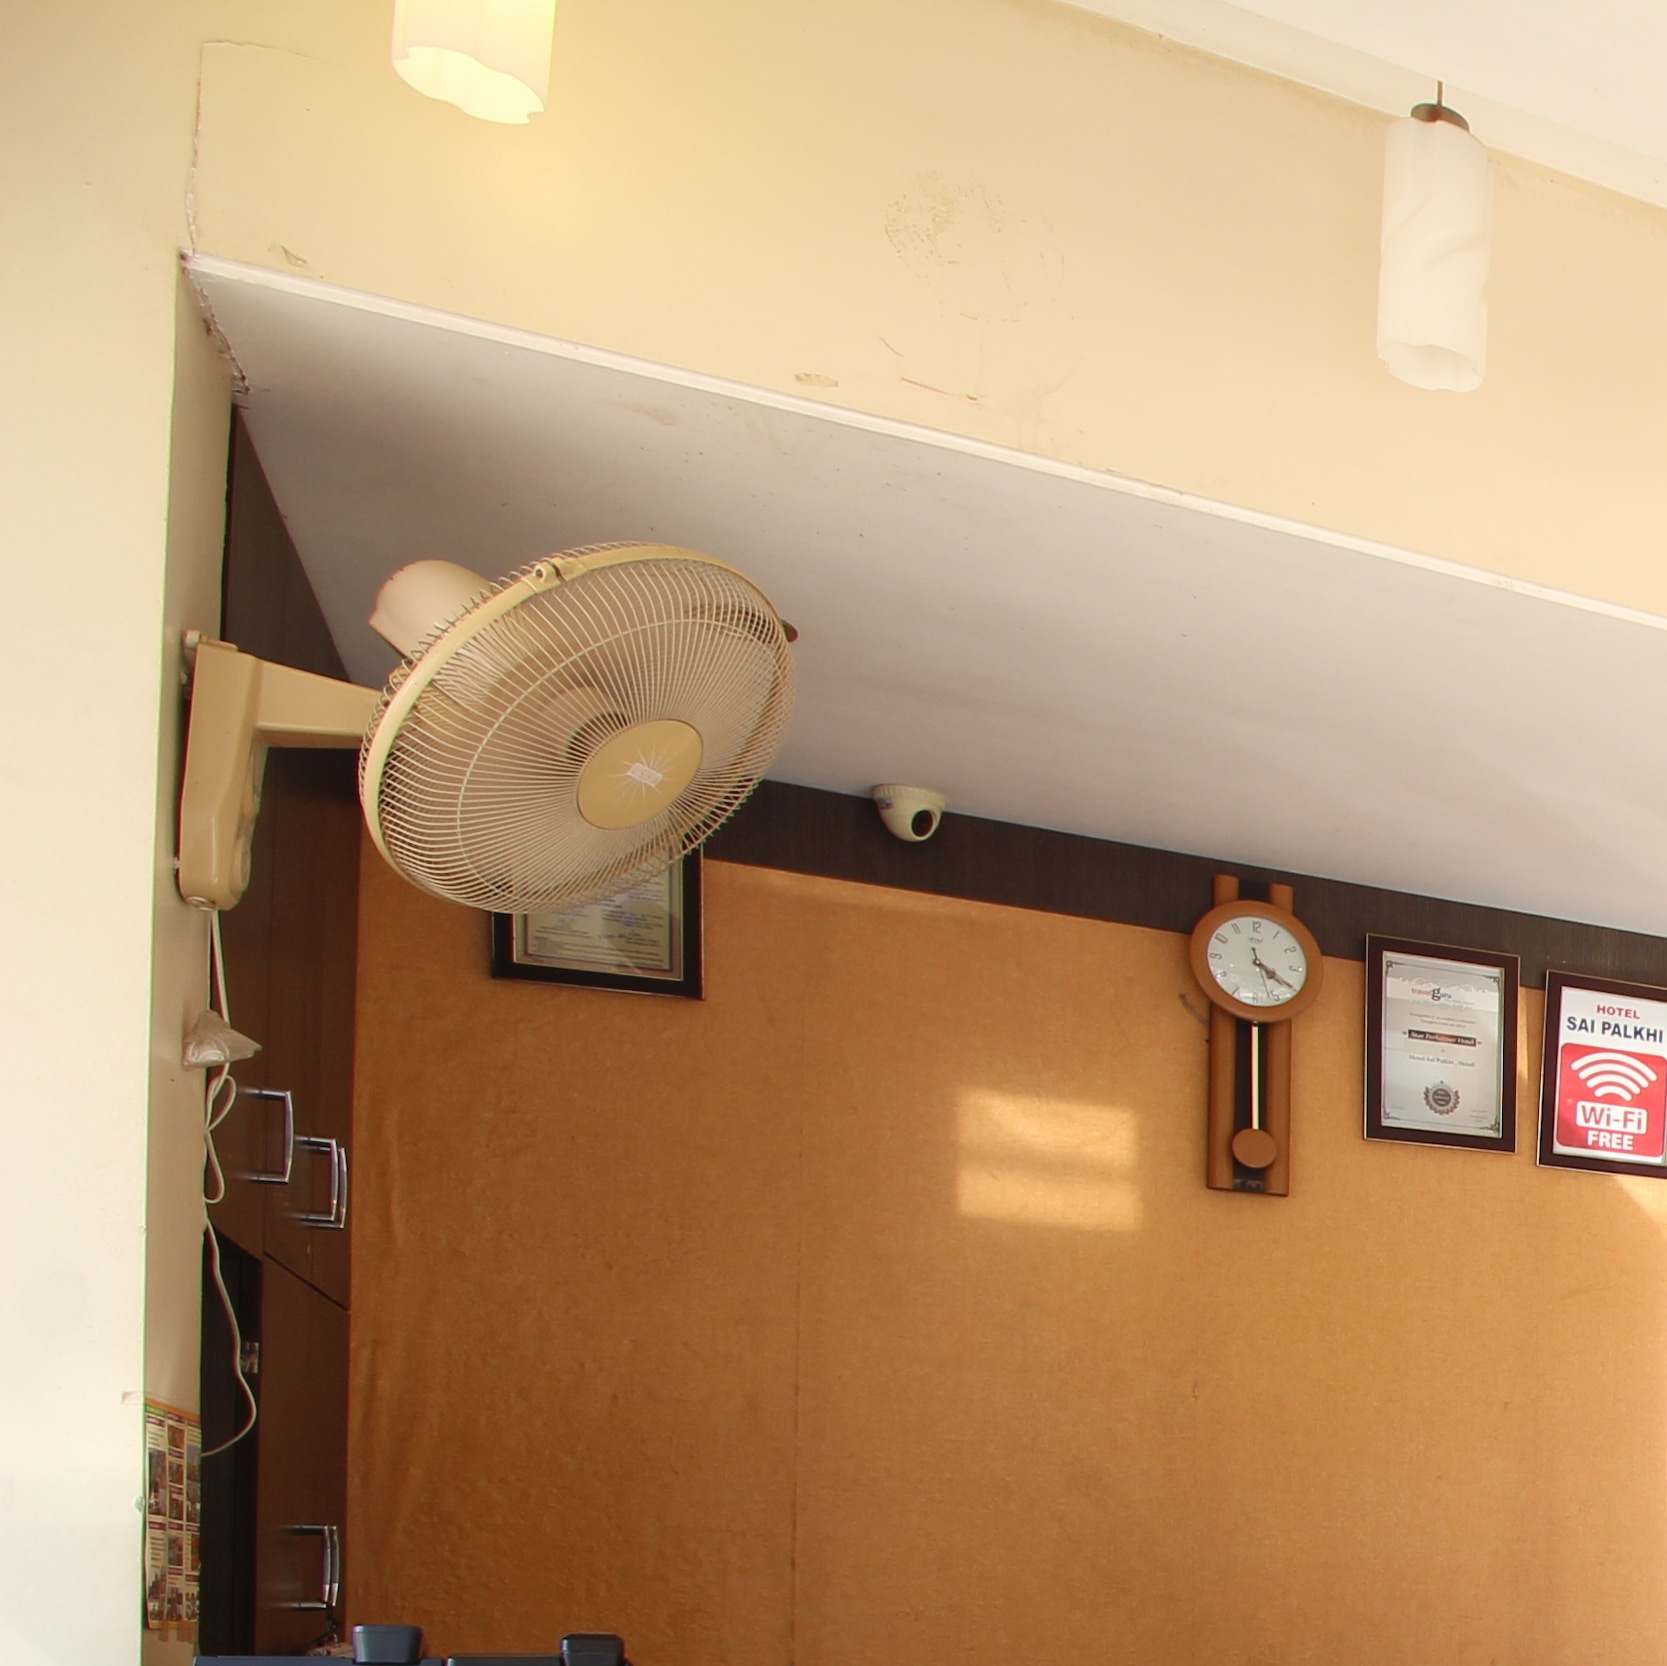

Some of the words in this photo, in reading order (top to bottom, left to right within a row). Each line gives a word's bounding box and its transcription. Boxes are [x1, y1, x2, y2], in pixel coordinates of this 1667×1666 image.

[1596, 1004, 1641, 1020] HOTEL
[1567, 1016, 1596, 1034] SAI
[1601, 1021, 1664, 1044] PALKHI
[1581, 1104, 1644, 1131] Wi-Fi
[1586, 1130, 1634, 1151] FREE
